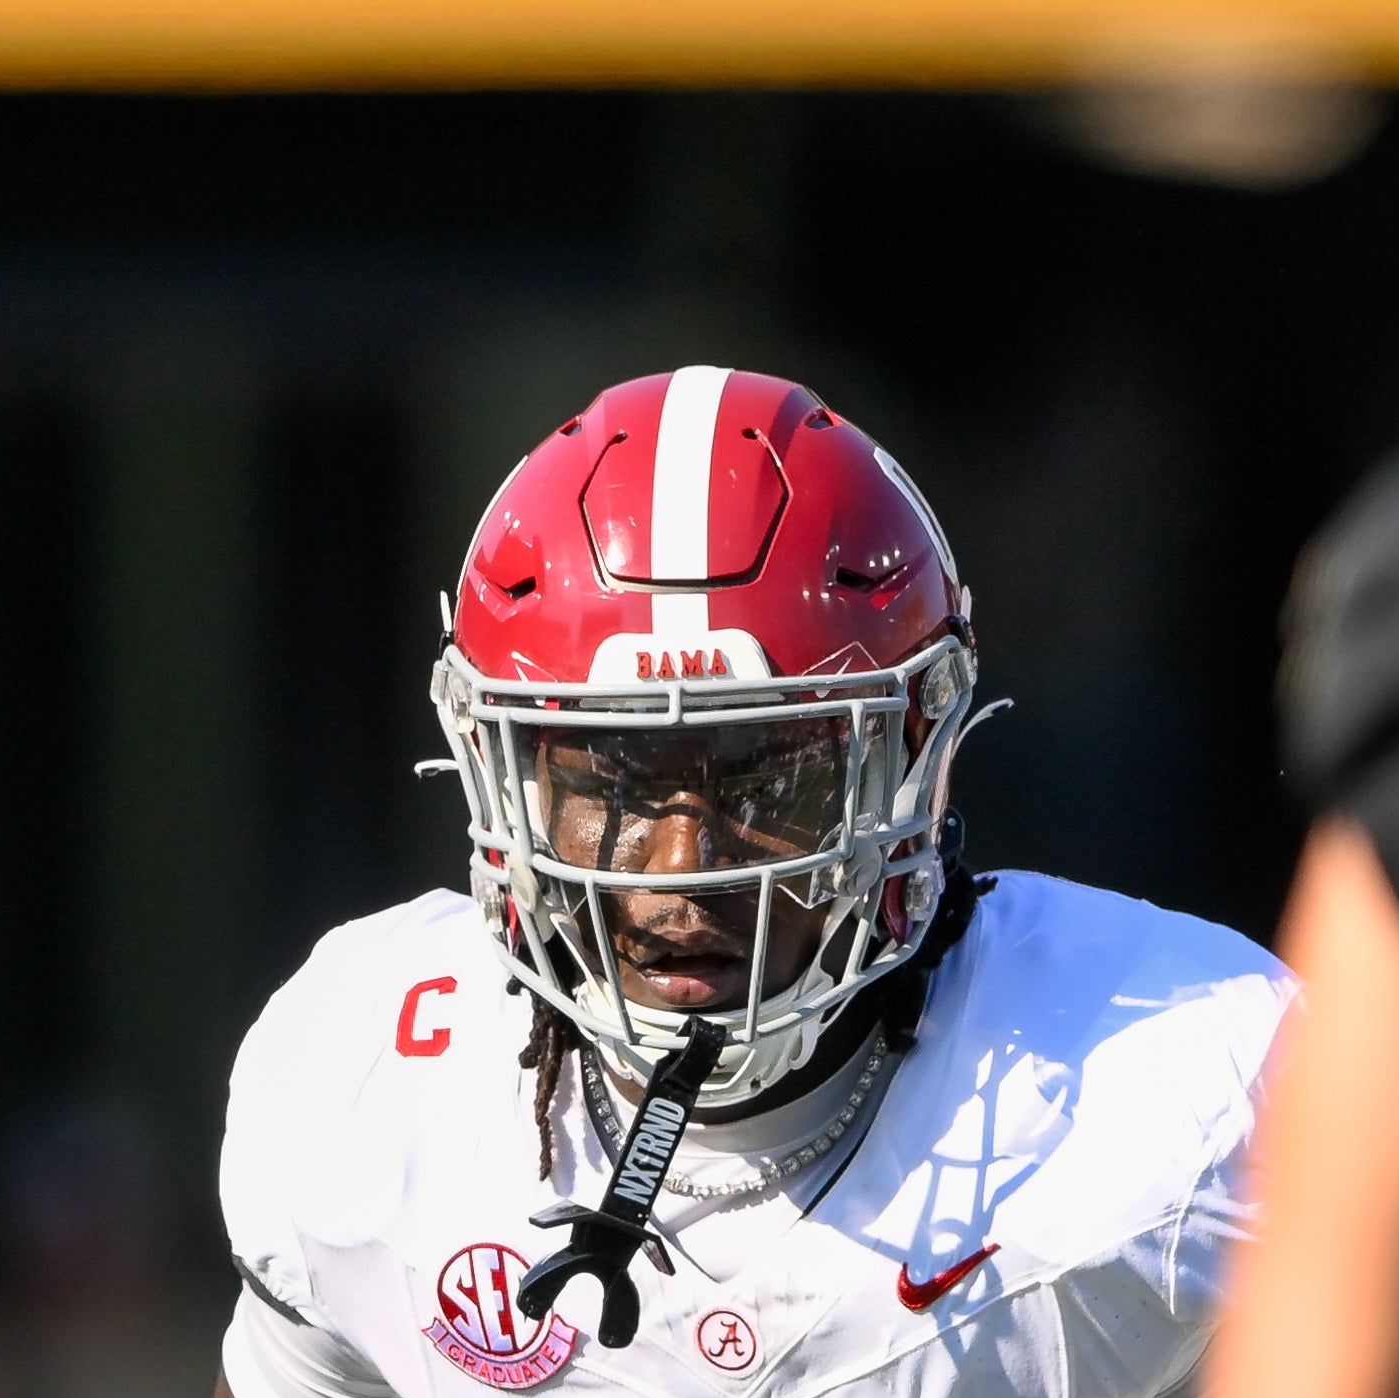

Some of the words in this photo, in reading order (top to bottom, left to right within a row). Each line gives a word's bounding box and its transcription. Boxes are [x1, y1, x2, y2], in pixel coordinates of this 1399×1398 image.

[636, 648, 727, 679] BAMA
[396, 976, 458, 1057] C
[613, 1097, 685, 1206] NXTRND
[708, 1321, 745, 1357] A
[446, 1344, 562, 1384] GRADUATE
